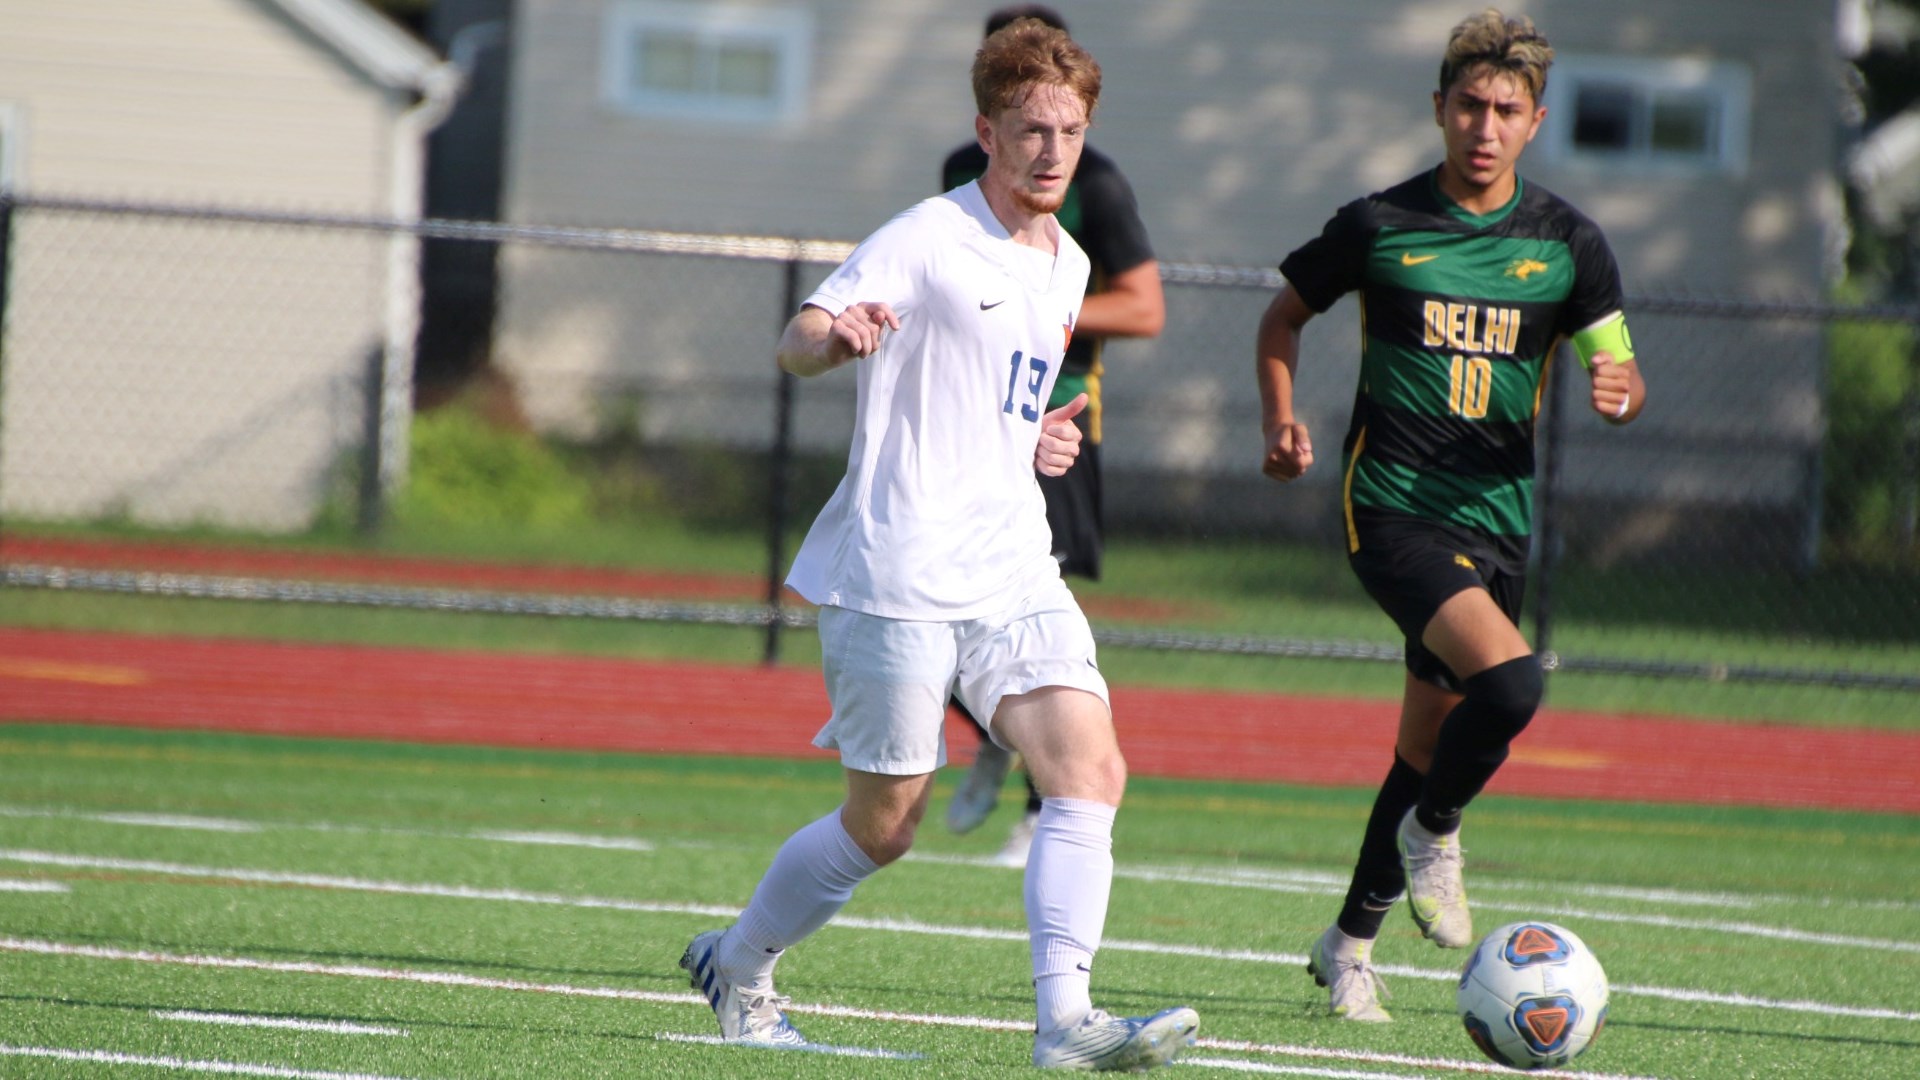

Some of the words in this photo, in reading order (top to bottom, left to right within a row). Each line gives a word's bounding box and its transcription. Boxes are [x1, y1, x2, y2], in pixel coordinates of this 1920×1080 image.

[1424, 300, 1521, 355] DELHI
[1003, 350, 1048, 423] 19
[1448, 355, 1492, 419] 10
